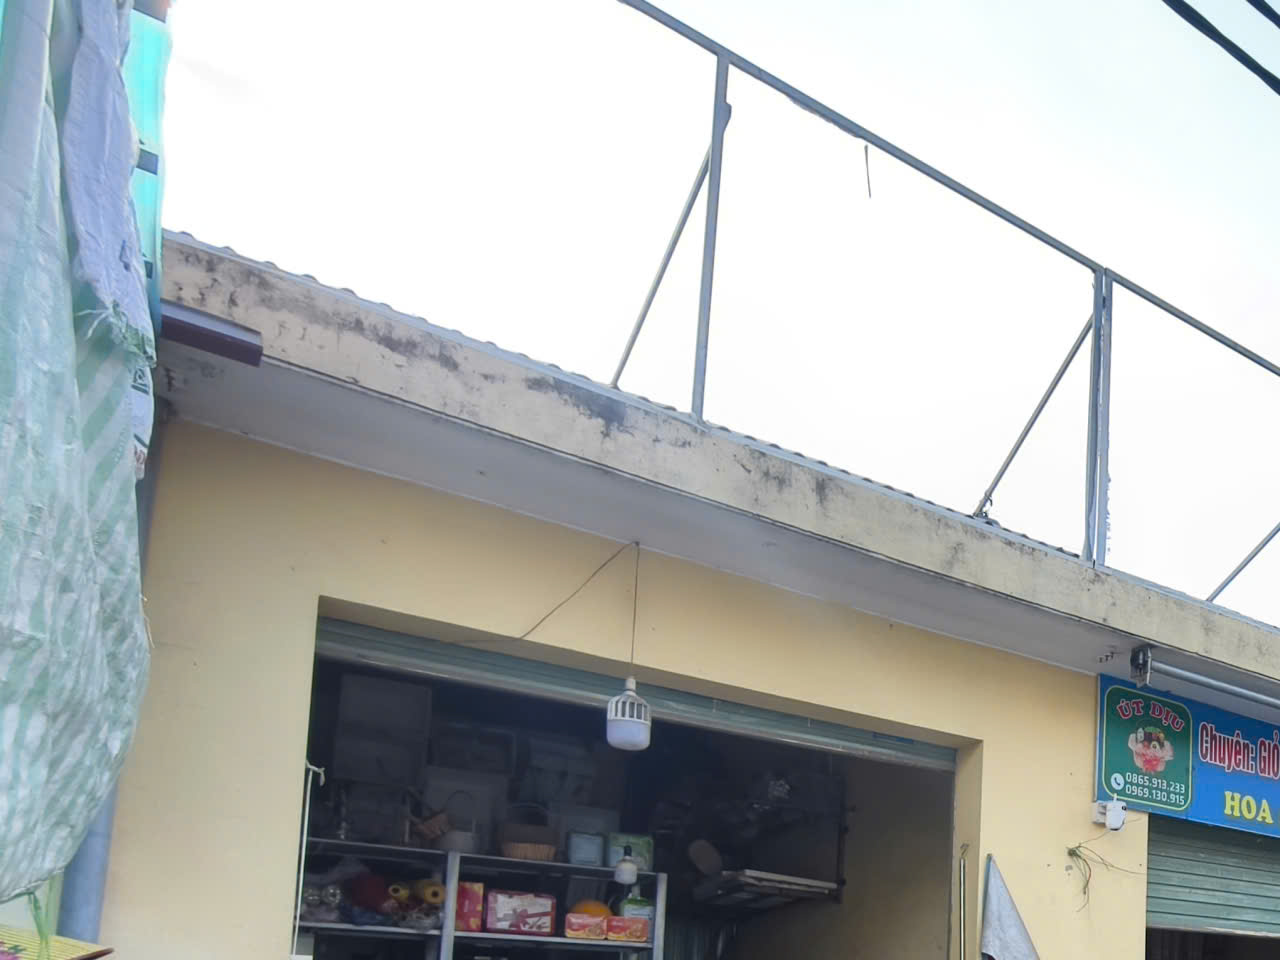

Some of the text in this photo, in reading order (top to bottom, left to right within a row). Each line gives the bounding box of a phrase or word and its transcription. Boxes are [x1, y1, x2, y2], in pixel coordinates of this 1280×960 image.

[1117, 699, 1185, 732] ÚT DỊU
[1199, 722, 1255, 773] Chuyên:
[1257, 730, 1280, 780] GIỎ
[1125, 772, 1185, 794] 0865.913.233
[1125, 784, 1185, 805] 0969.130.915
[1224, 791, 1274, 824] HOA
